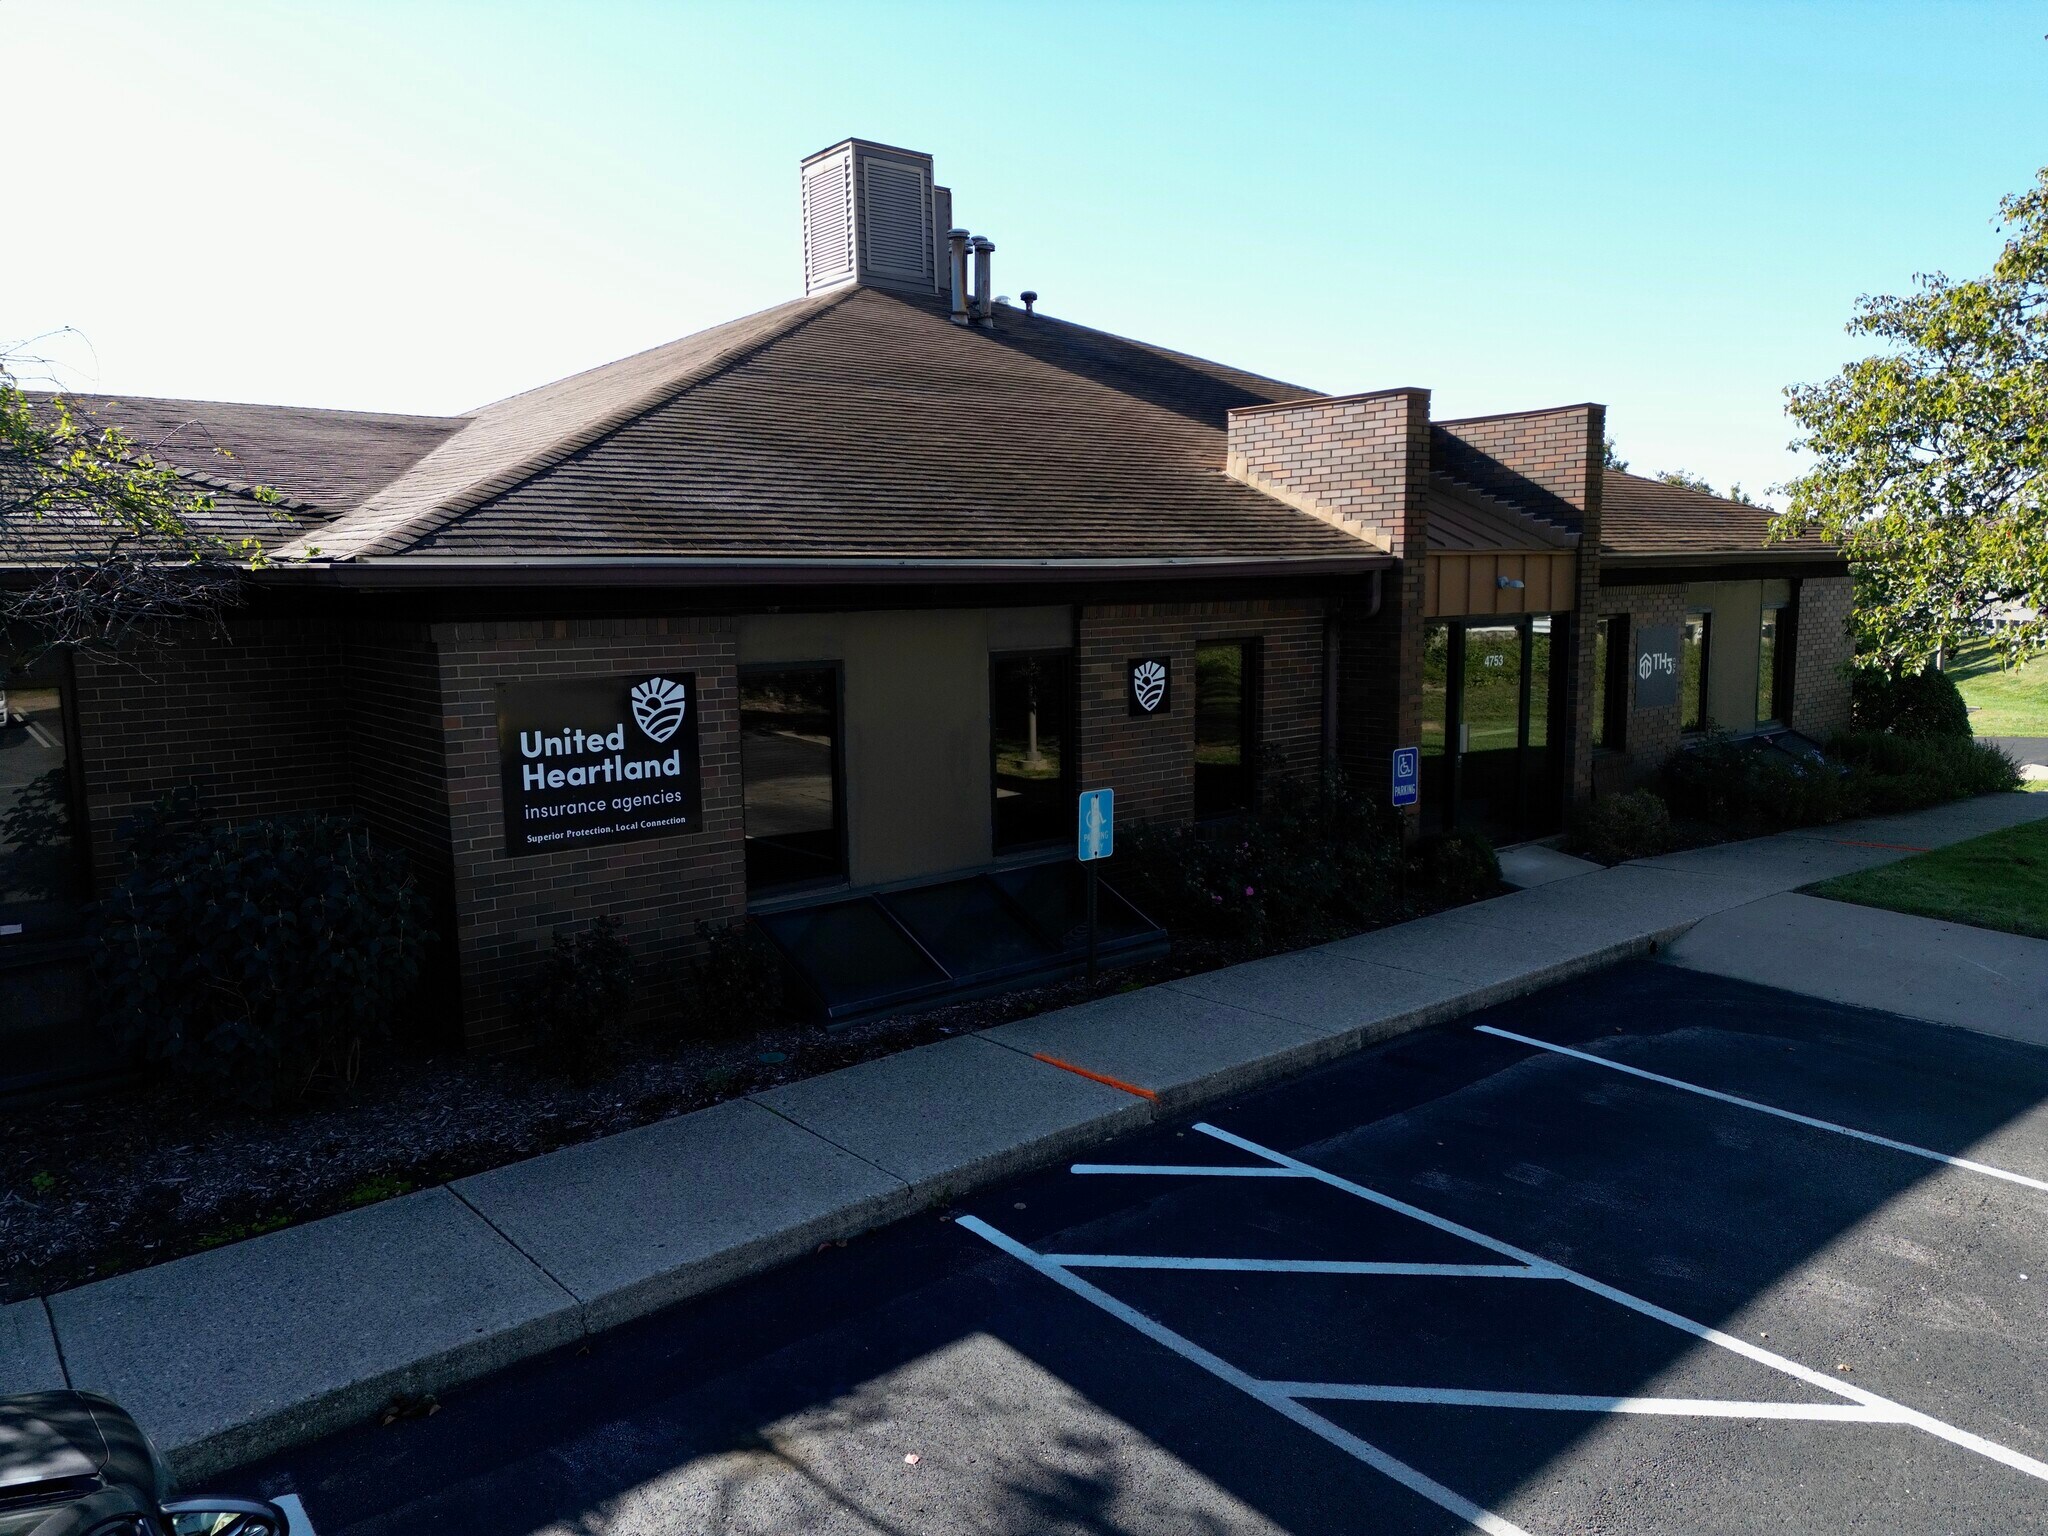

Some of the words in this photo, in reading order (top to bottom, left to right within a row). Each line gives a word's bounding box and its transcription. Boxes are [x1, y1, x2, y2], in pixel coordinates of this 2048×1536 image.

[1484, 654, 1504, 667] 4753
[520, 723, 625, 758] United
[523, 749, 680, 790] Heartland
[525, 800, 606, 819] insurance
[611, 789, 682, 812] agencies
[1394, 784, 1415, 797] PARKING
[526, 832, 564, 844] Superior
[615, 821, 638, 832] Local
[640, 816, 686, 829] Connection
